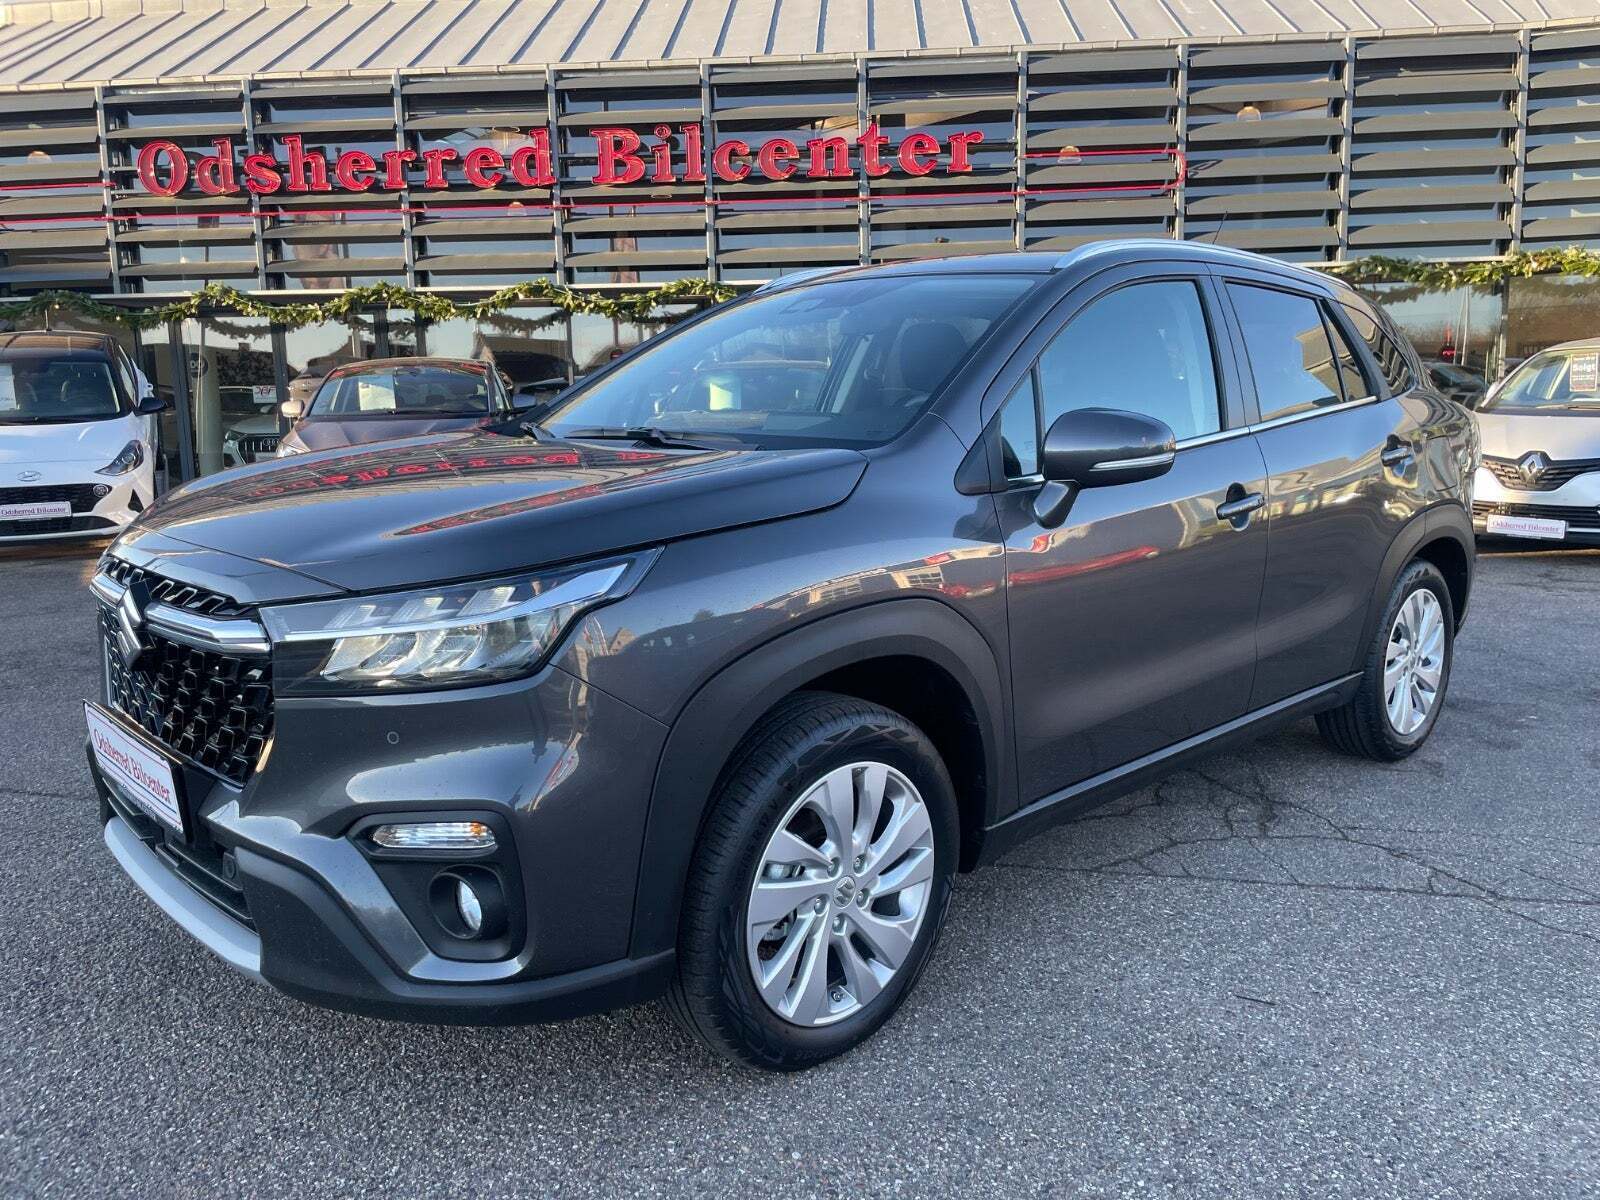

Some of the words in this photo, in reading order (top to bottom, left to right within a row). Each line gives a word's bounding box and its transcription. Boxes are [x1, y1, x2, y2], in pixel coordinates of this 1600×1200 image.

[137, 127, 557, 196] Odsherred
[589, 122, 984, 185] Bilcenter
[93, 728, 132, 774] Odsherred
[130, 753, 171, 805] Bilcenter
